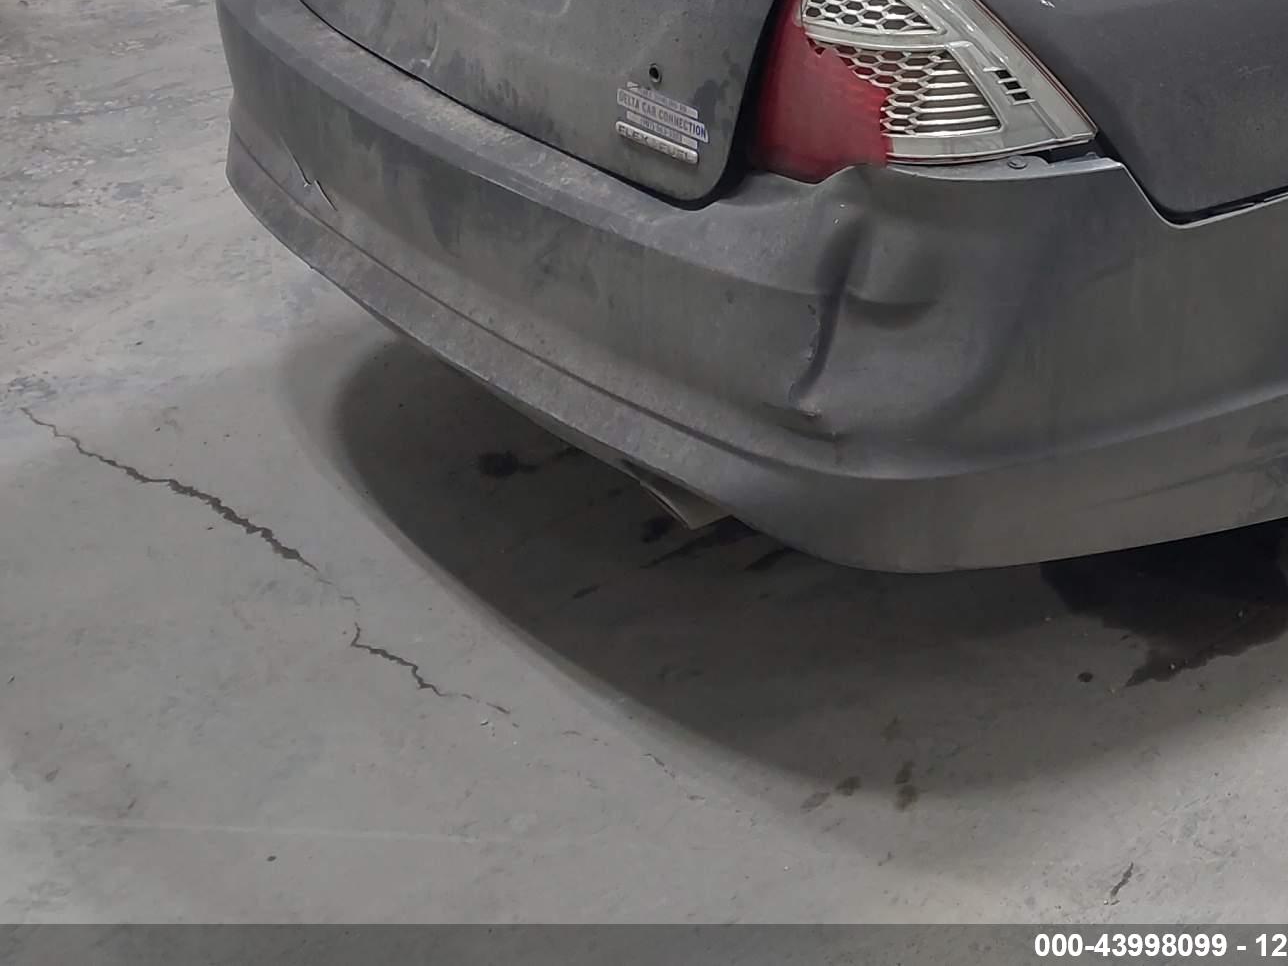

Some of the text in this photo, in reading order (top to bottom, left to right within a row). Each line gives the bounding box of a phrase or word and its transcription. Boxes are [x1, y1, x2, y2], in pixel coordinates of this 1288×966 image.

[618, 90, 640, 111] DELTA
[641, 101, 657, 118] CAR
[658, 110, 706, 140] CONNECTION
